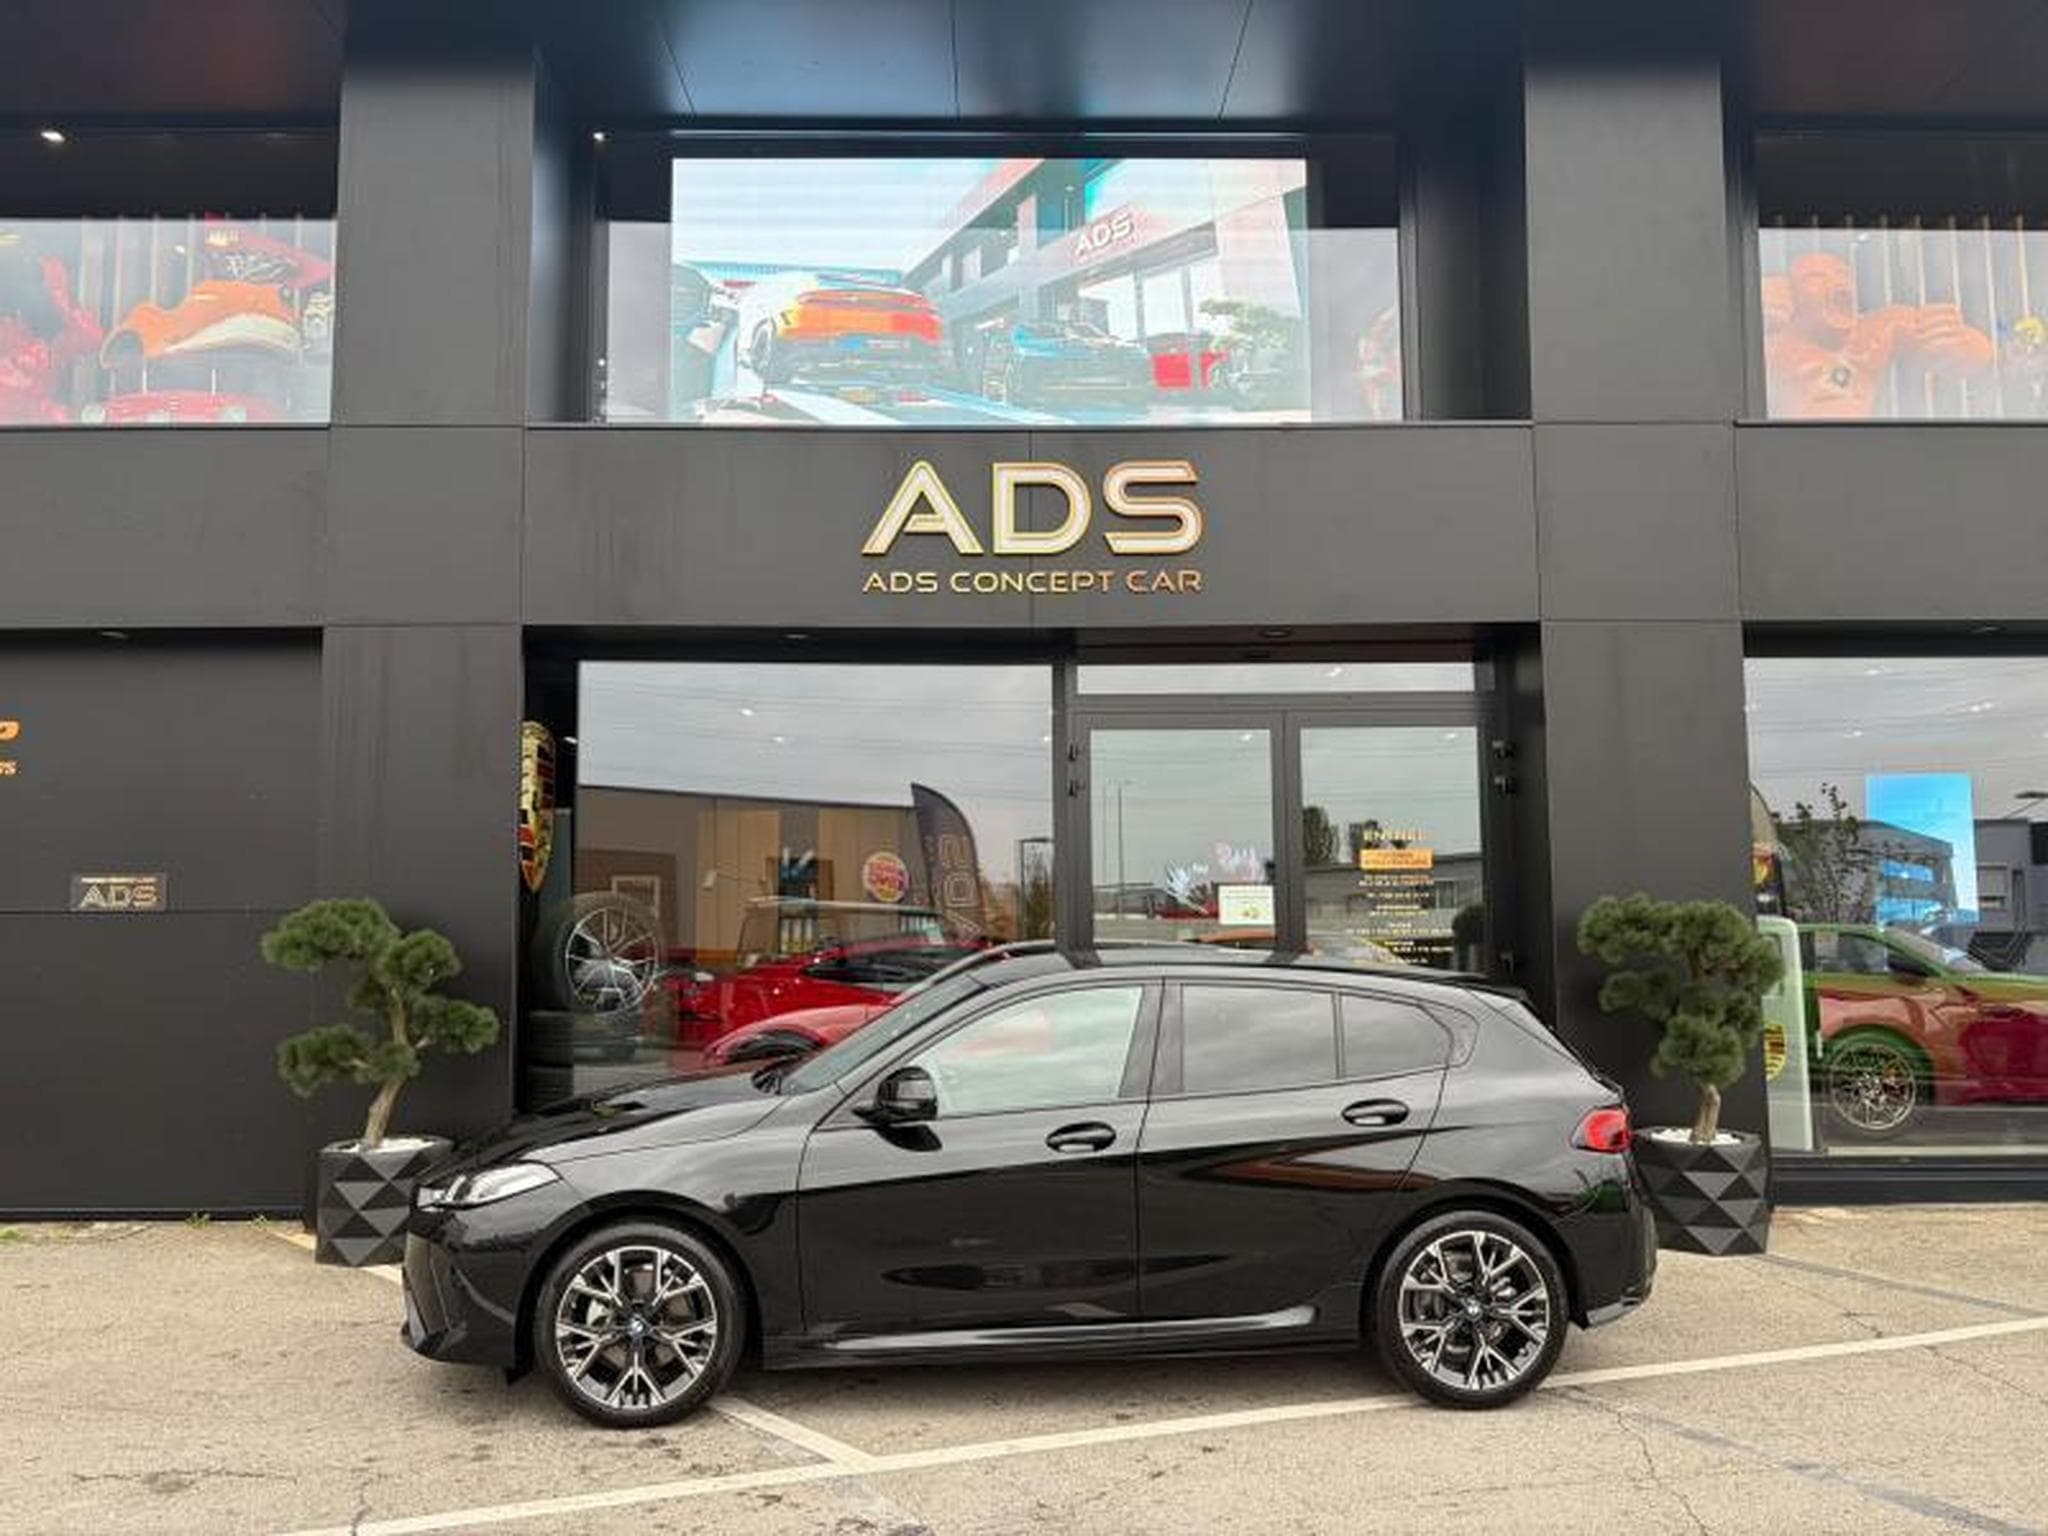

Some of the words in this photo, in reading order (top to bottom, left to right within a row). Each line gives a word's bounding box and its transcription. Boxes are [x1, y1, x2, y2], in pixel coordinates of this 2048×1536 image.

[1074, 212, 1132, 256] ADS
[860, 459, 1203, 555] ADS
[862, 571, 938, 593] ADS
[949, 571, 1114, 593] CONCEPT
[1125, 570, 1202, 592] CAR
[80, 884, 158, 907] ADS
